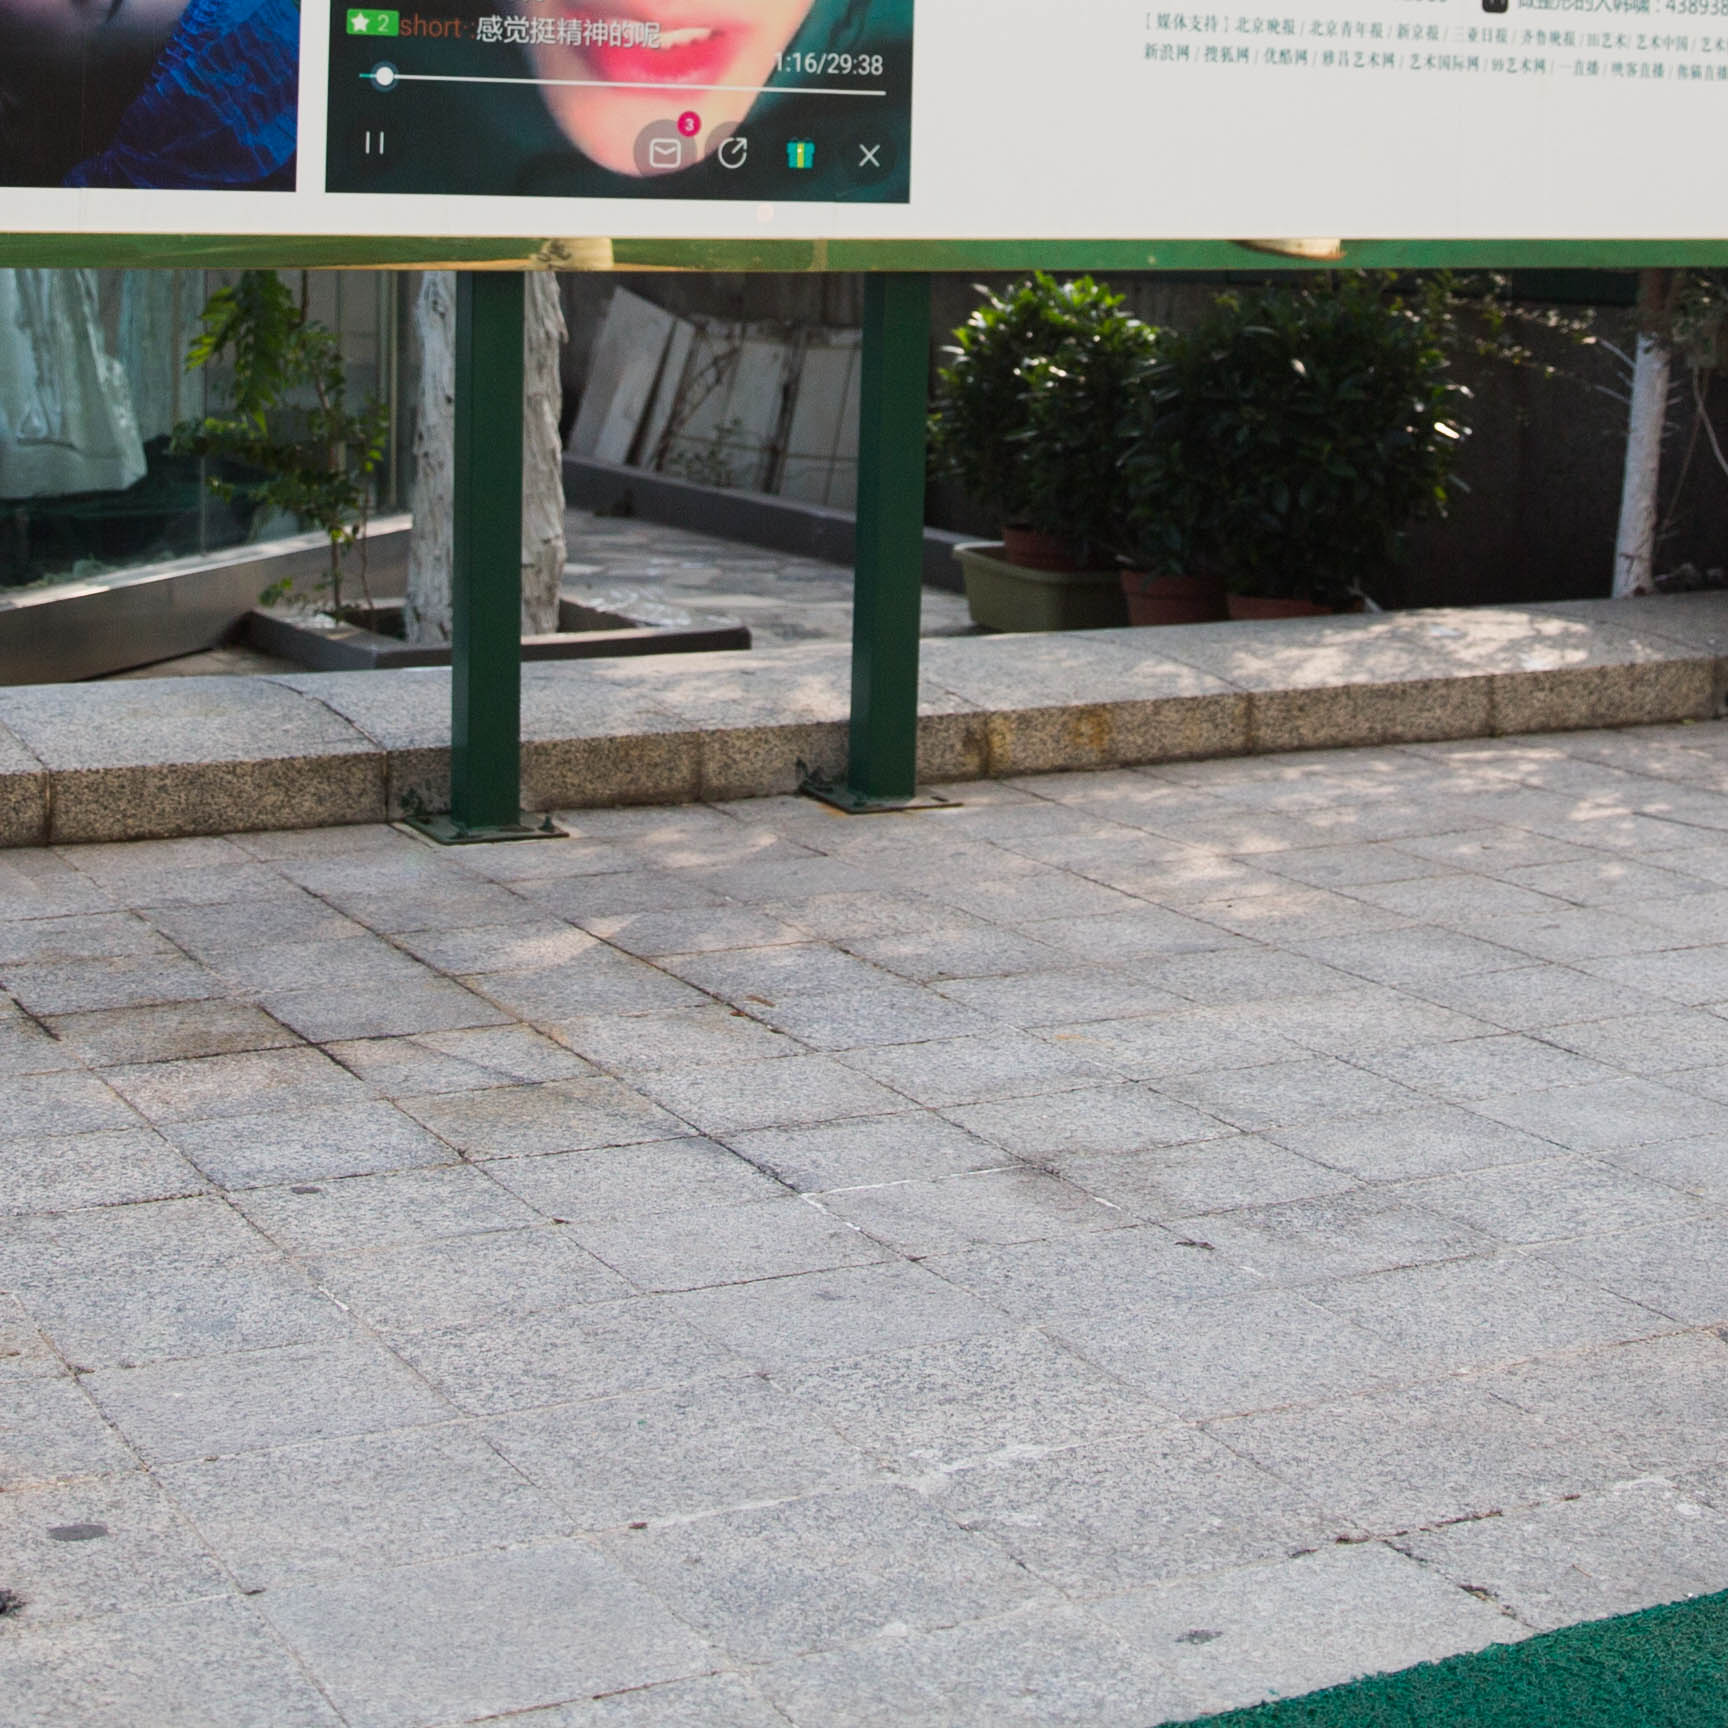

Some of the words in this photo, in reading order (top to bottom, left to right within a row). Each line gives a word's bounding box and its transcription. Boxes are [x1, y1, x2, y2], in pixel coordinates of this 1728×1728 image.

[377, 14, 390, 32] 2
[400, 13, 461, 39] short
[776, 52, 884, 76] 1:16/29:38
